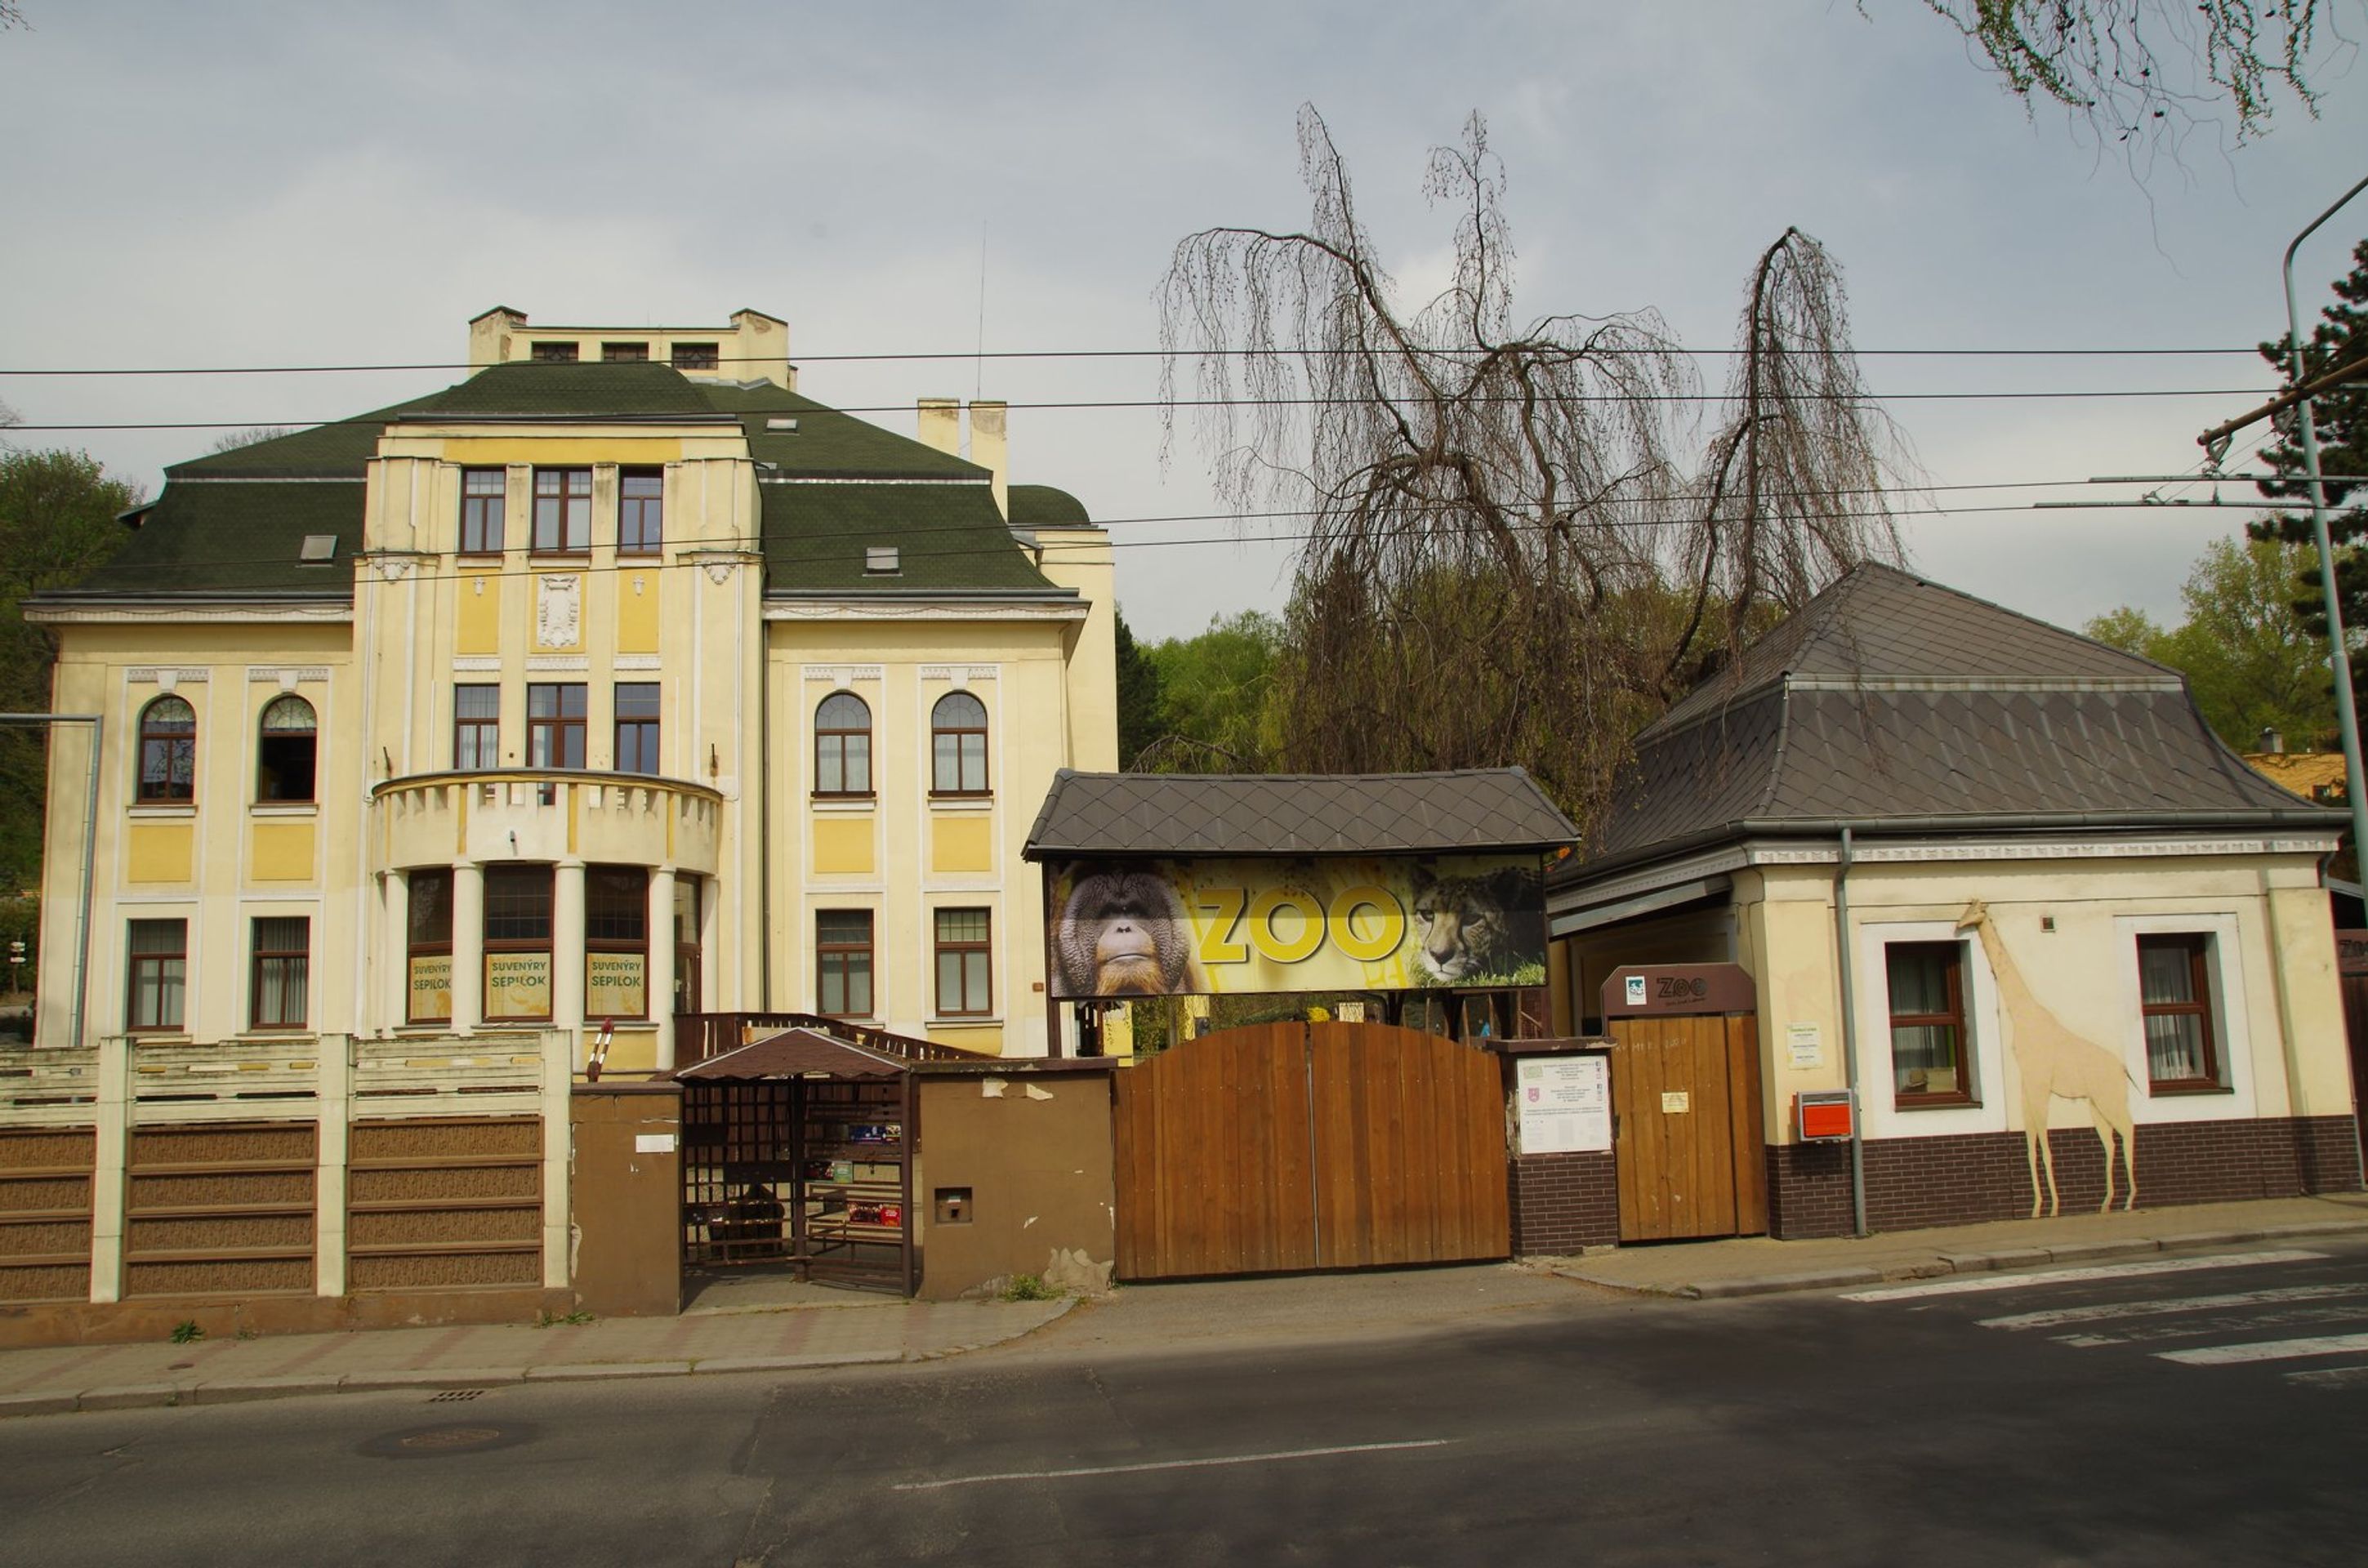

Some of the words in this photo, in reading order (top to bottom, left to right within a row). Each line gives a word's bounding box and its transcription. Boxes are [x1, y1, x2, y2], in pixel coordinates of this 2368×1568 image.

[1197, 884, 1407, 965] ZOO
[2339, 939, 2368, 958] ZO
[414, 962, 452, 974] SUVENÝRY
[492, 959, 546, 971] SUVENÝRY
[591, 959, 641, 971] SUVENÝRY
[413, 978, 452, 990] SEPILOK
[492, 976, 546, 987] SEPILOK
[591, 975, 641, 987] SEPILOK
